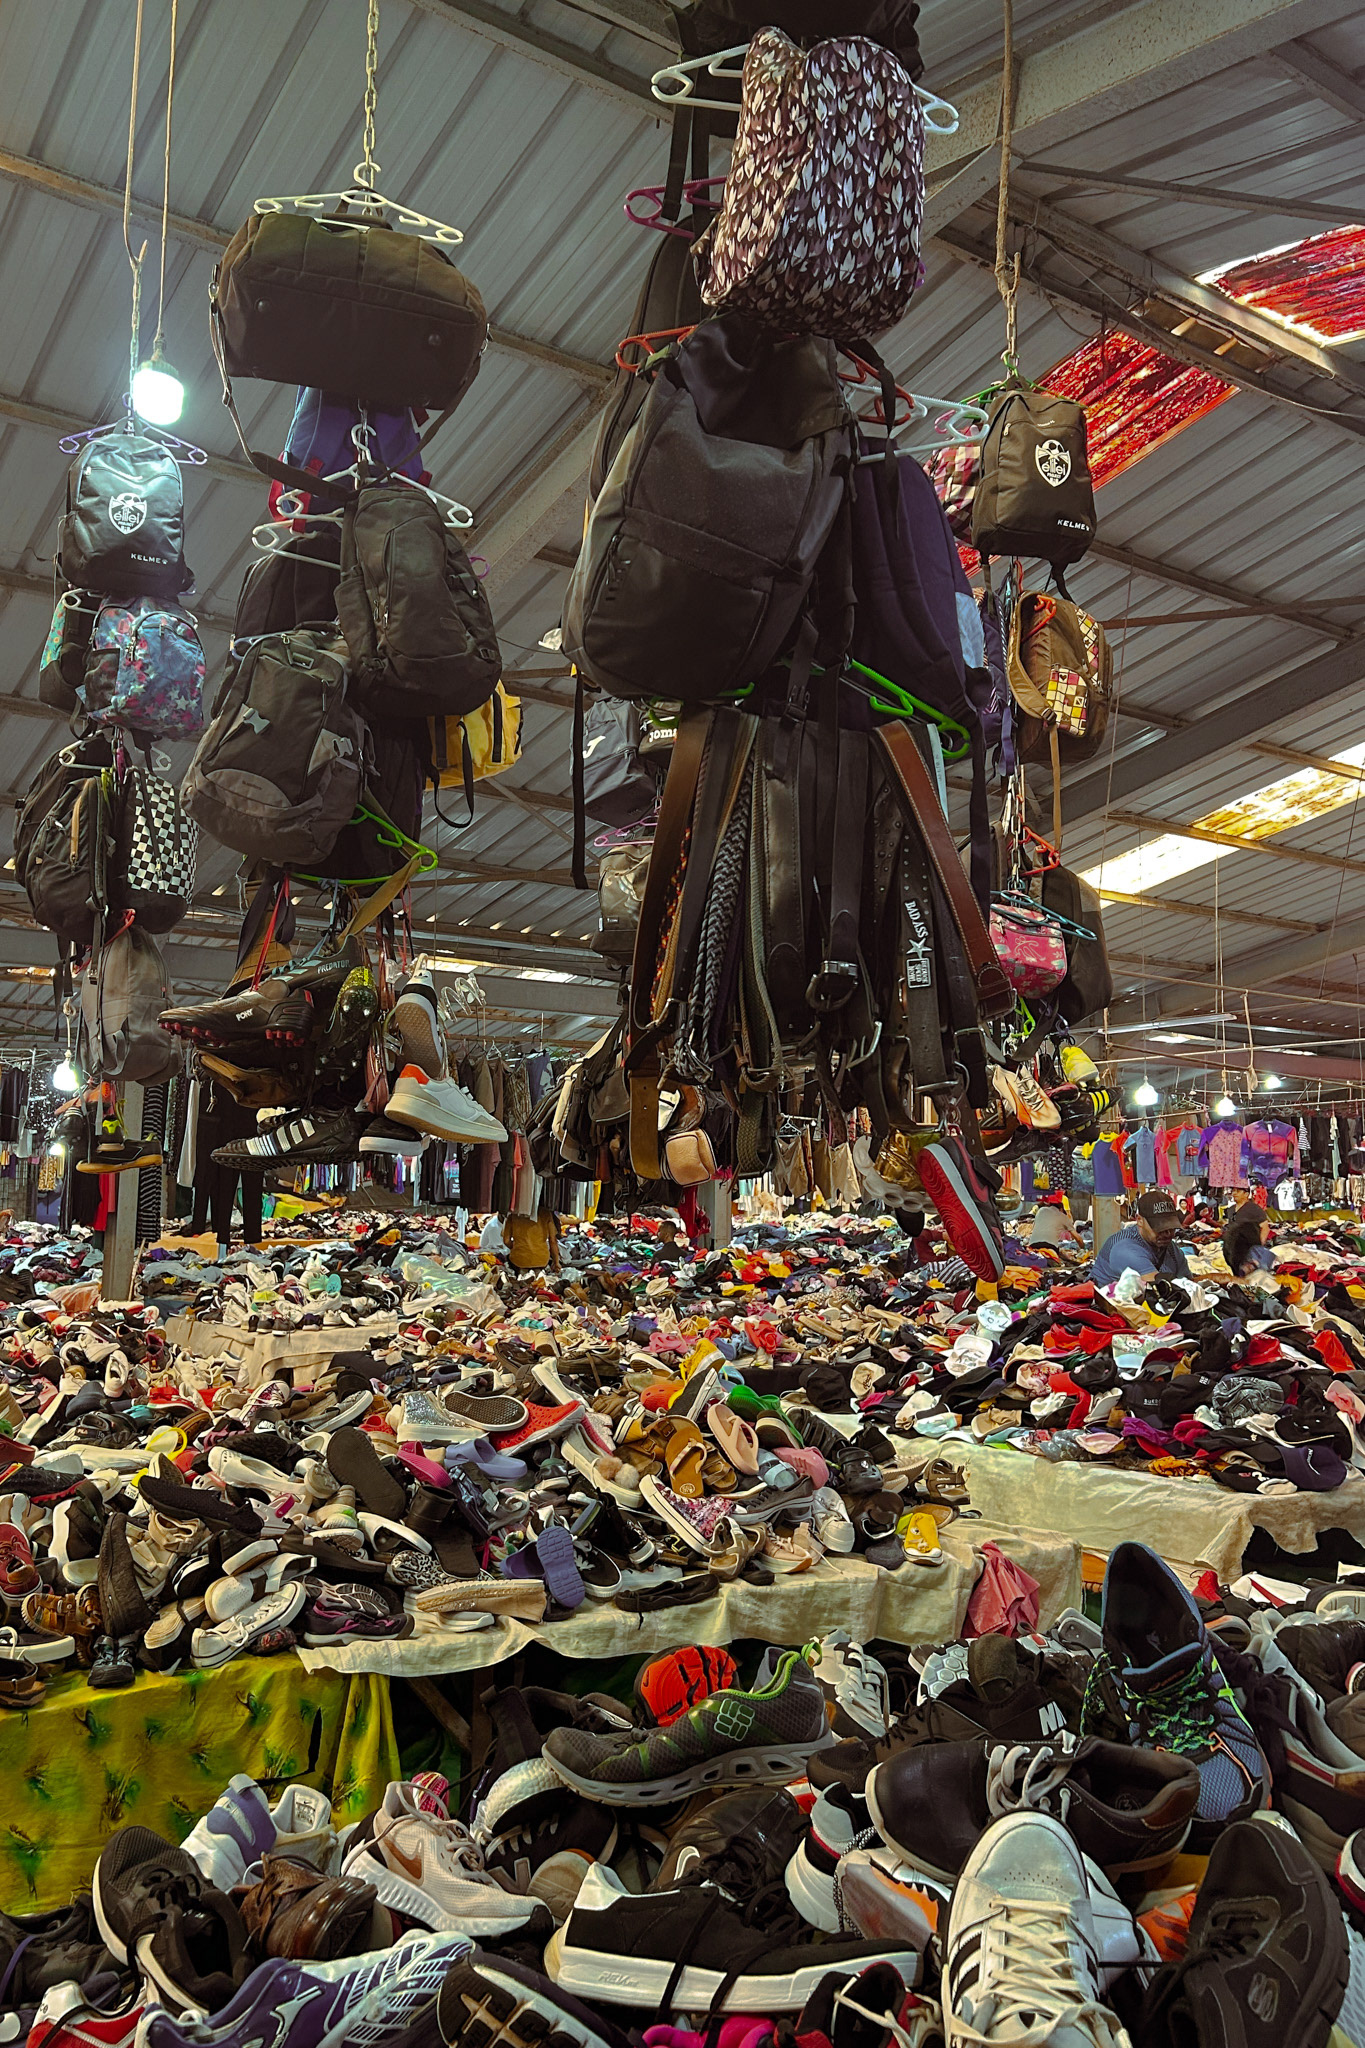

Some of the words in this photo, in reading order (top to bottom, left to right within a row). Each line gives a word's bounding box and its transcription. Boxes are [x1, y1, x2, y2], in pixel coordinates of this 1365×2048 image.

[1057, 519, 1087, 531] KELME
[130, 553, 161, 564] KELME
[904, 900, 921, 921] BAD
[912, 921, 929, 939] ASS
[317, 960, 351, 974] PREDATOR
[235, 1008, 254, 1021] PONY
